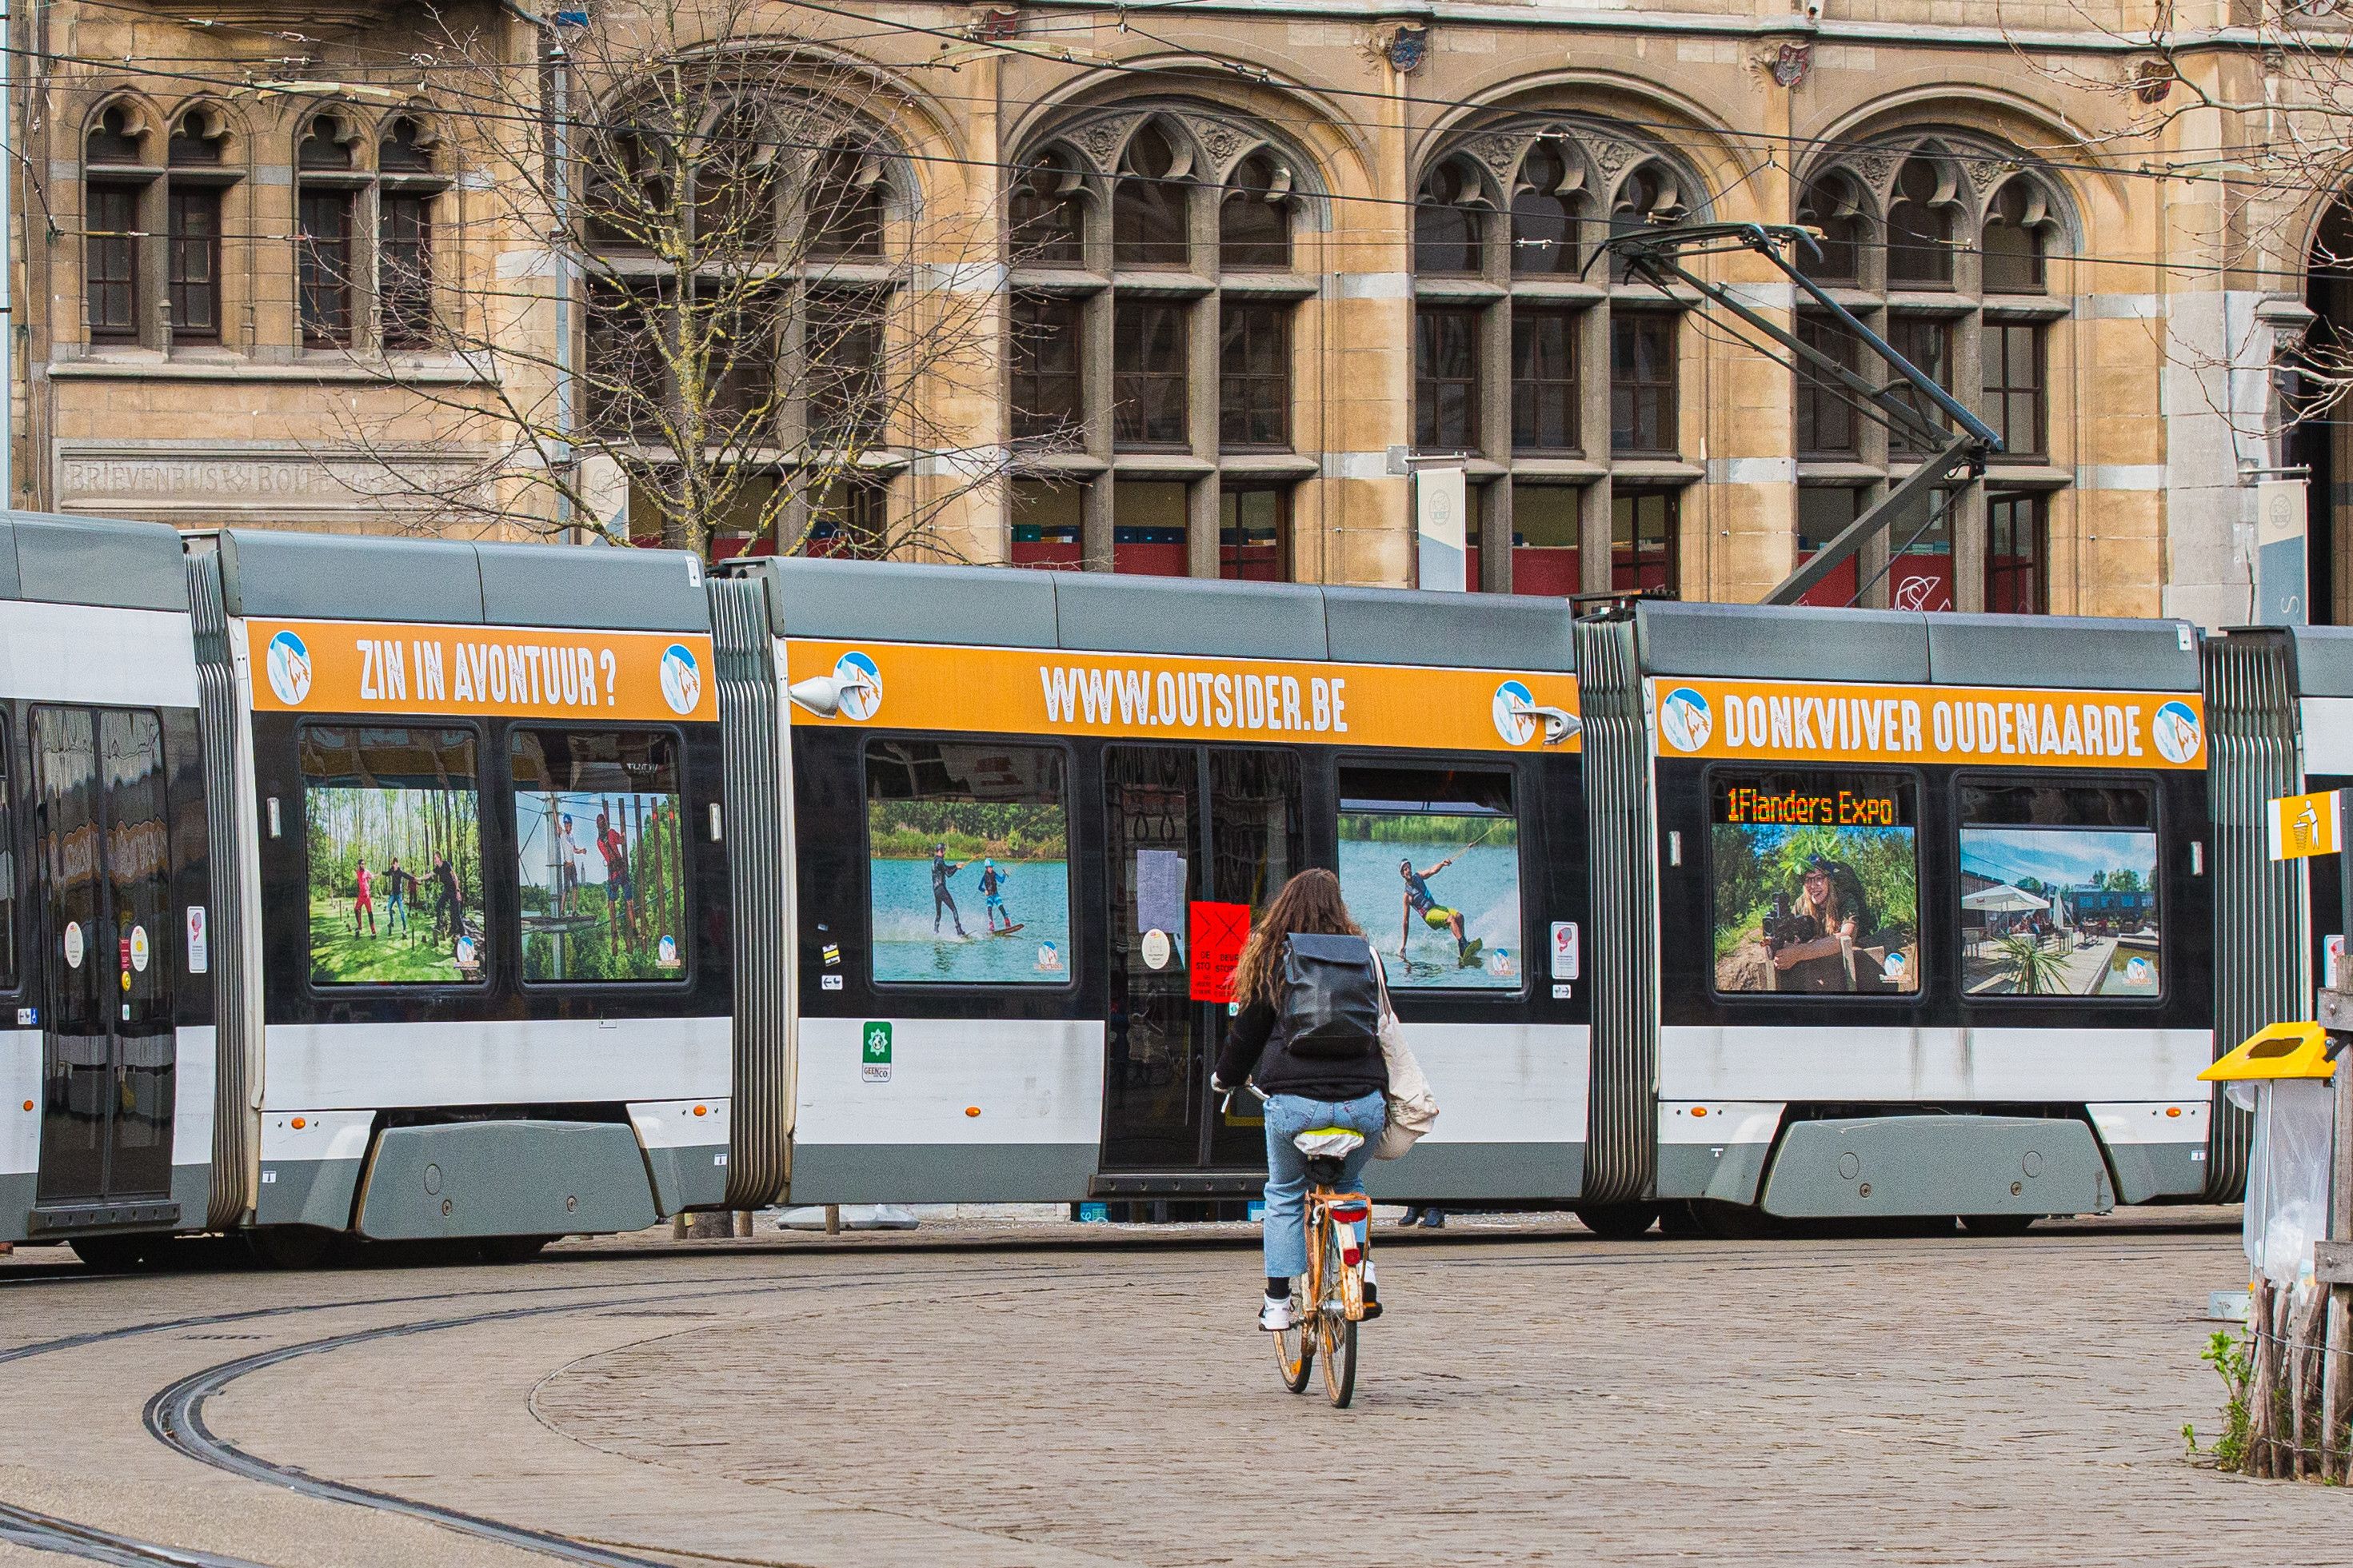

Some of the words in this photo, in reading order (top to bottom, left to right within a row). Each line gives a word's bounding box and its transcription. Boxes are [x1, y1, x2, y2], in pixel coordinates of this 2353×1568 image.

[69, 463, 218, 493] BRIEVENBUS
[356, 640, 406, 700] ZIN
[413, 640, 445, 700] IN
[1040, 666, 1348, 732] WWW.OUTSIDER.BE
[1724, 695, 1923, 752] DONKVIJVER
[1932, 700, 2143, 756] OUDENAARDE
[1839, 791, 1892, 825] Expo
[864, 1067, 879, 1075] GEEN
